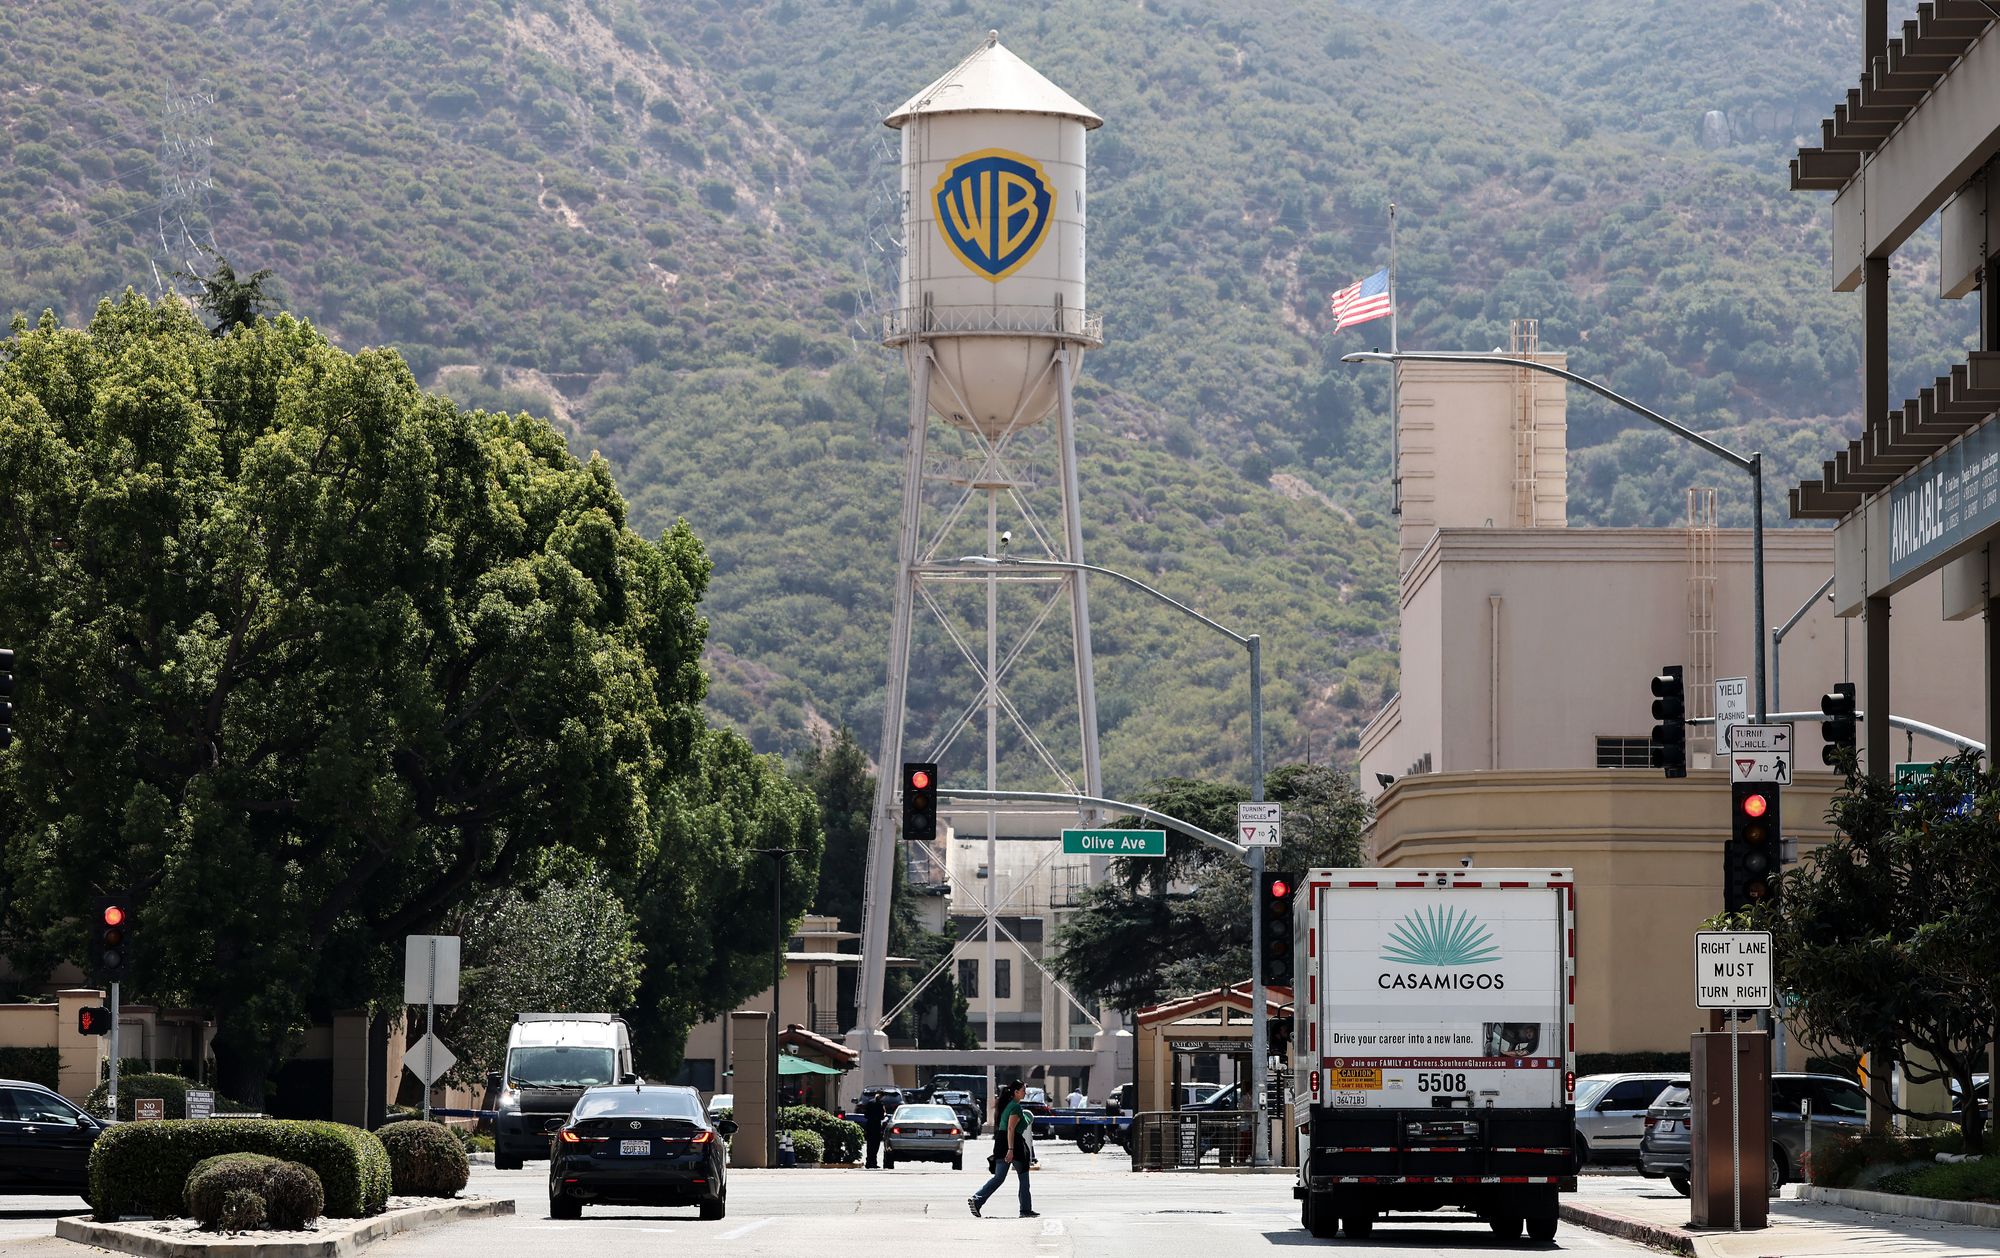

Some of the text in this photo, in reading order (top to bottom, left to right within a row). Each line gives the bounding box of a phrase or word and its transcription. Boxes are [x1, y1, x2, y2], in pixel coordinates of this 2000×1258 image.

[945, 170, 1039, 260] WB
[1891, 472, 1943, 564] AVAILABLE
[1719, 683, 1743, 696] YIELD
[1727, 700, 1736, 708] ON
[1718, 711, 1745, 720] FLASHING
[1759, 764, 1768, 773] TO
[1081, 835, 1146, 849] Olive Ave
[1701, 942, 1767, 954] RIGHT LANE
[1714, 963, 1754, 977] MUST
[1378, 973, 1504, 990] CASAMIGOS
[1700, 986, 1767, 998] TURN RIGHT
[1334, 1033, 1474, 1046] Drive your career into a new lane.
[1418, 1073, 1466, 1092] 5508
